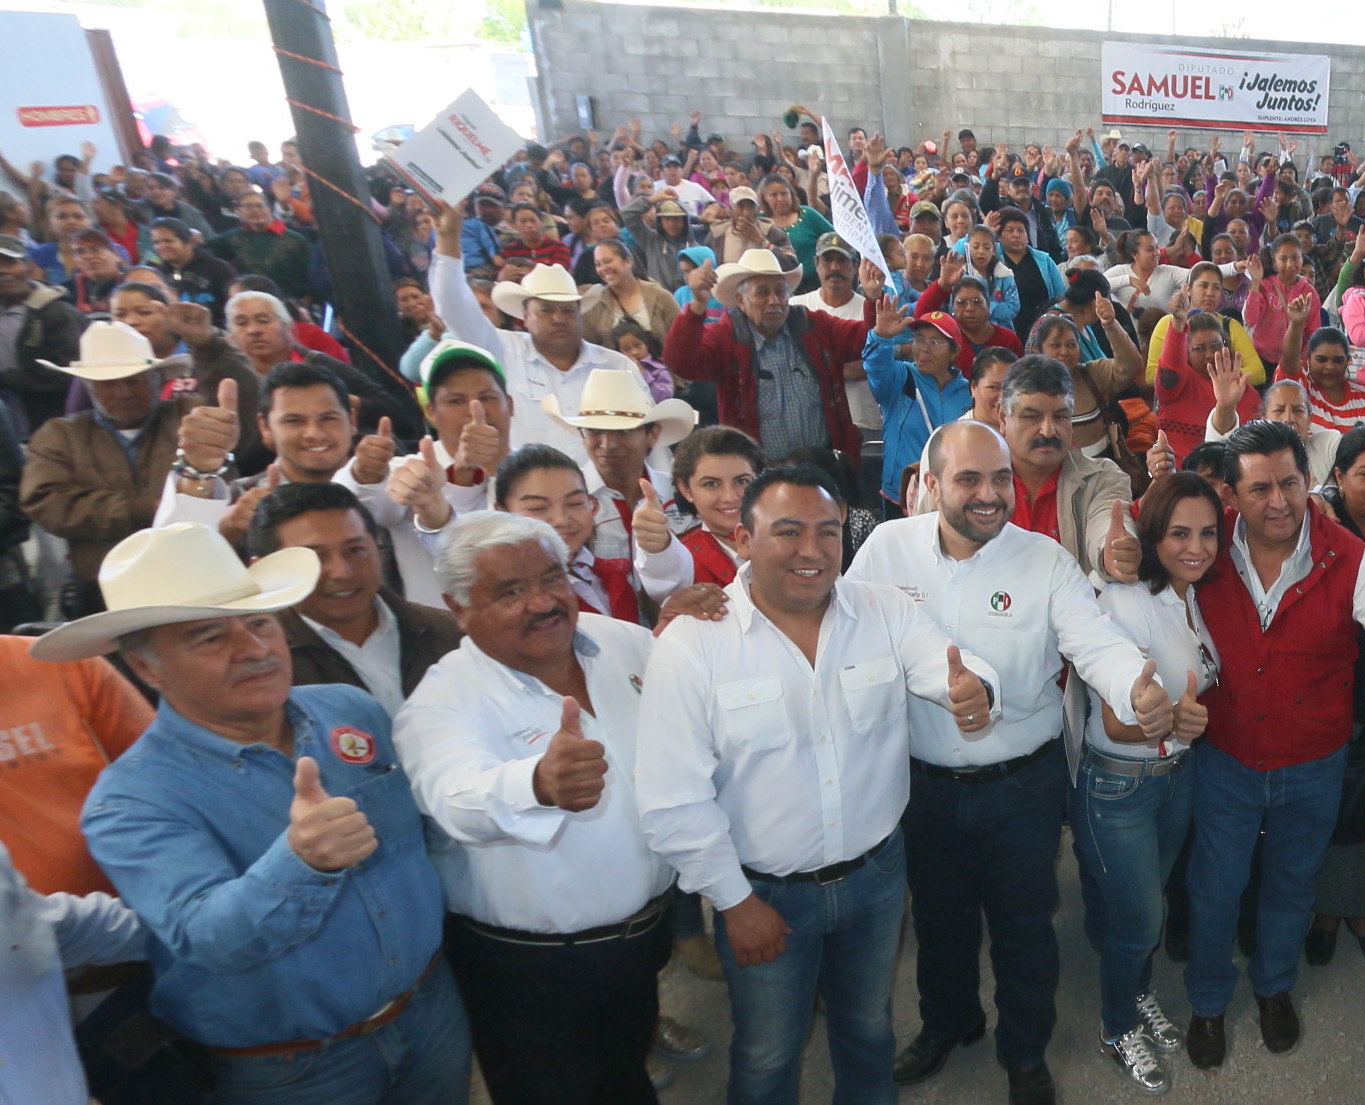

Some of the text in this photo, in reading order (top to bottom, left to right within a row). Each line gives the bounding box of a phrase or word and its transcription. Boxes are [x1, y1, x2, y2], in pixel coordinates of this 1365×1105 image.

[1178, 63, 1235, 75] DIPUTADO
[1111, 70, 1216, 100] SAMUEL
[1238, 71, 1318, 93] ¡Jalemos
[1125, 99, 1176, 112] Rodríguez
[1256, 92, 1321, 112] Juntos!
